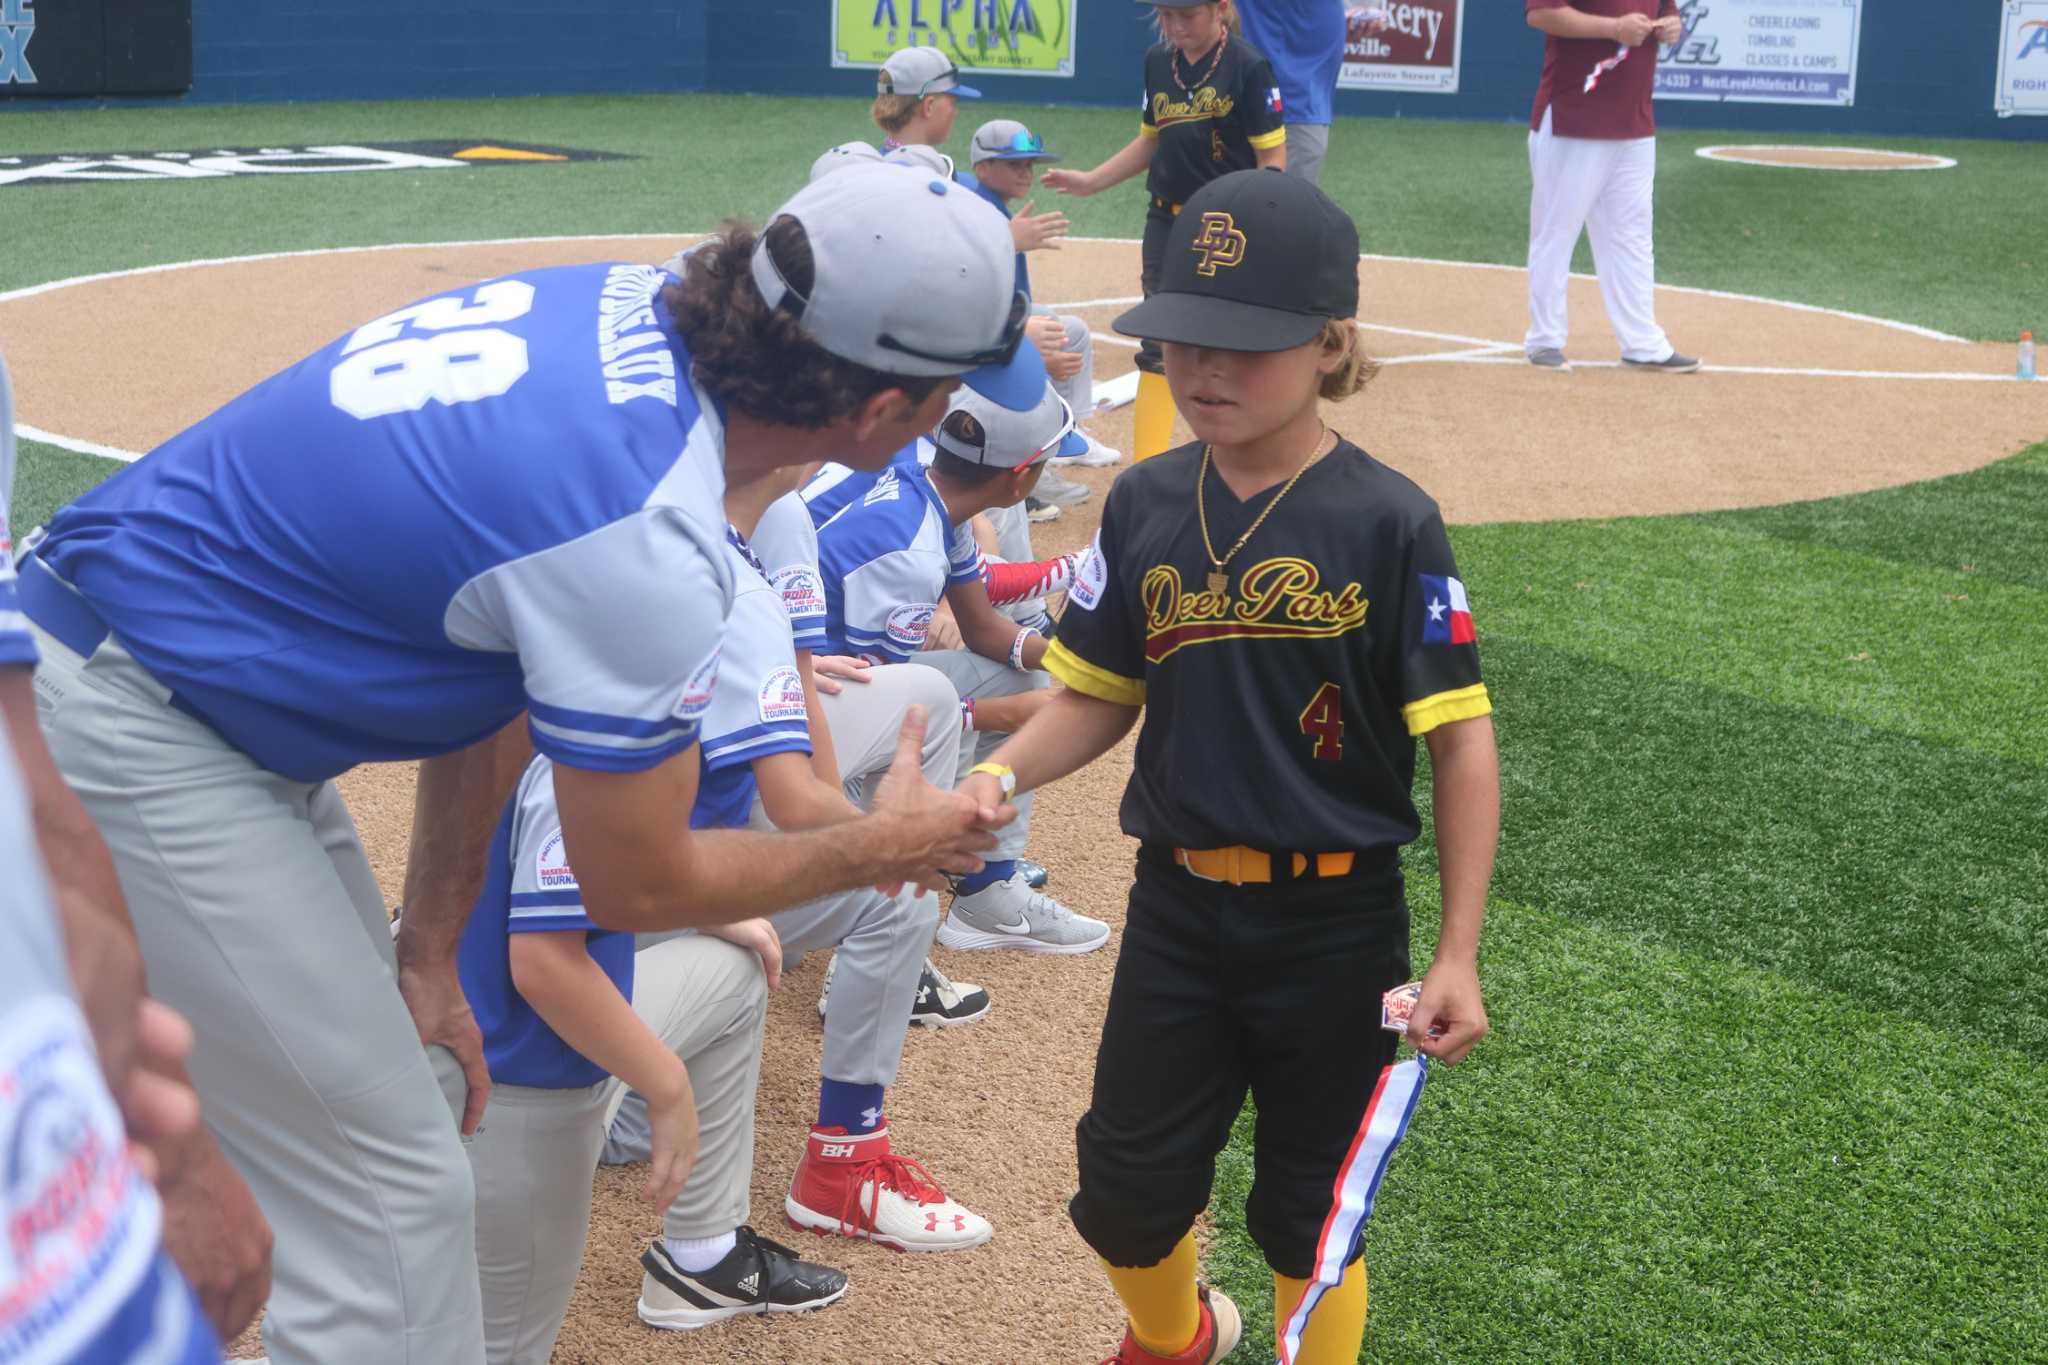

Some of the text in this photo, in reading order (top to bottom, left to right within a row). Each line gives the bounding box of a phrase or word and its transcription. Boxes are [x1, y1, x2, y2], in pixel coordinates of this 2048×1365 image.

[872, 0, 1035, 32] ALPHA
[1748, 15, 1821, 30] CHEERLEADING
[1747, 34, 1796, 48] TUMBLING
[1745, 54, 1838, 69] CLASSES & CAMPS
[1344, 67, 1436, 82] Lafayette Street
[1703, 74, 1829, 91] NextLevelAthleticsLA.com
[2012, 78, 2048, 91] RIGH
[329, 279, 536, 421] 28
[1141, 557, 1369, 634] Deer Park
[1298, 682, 1345, 762] 4
[820, 1144, 855, 1158] BH
[737, 1281, 759, 1297] adidas
